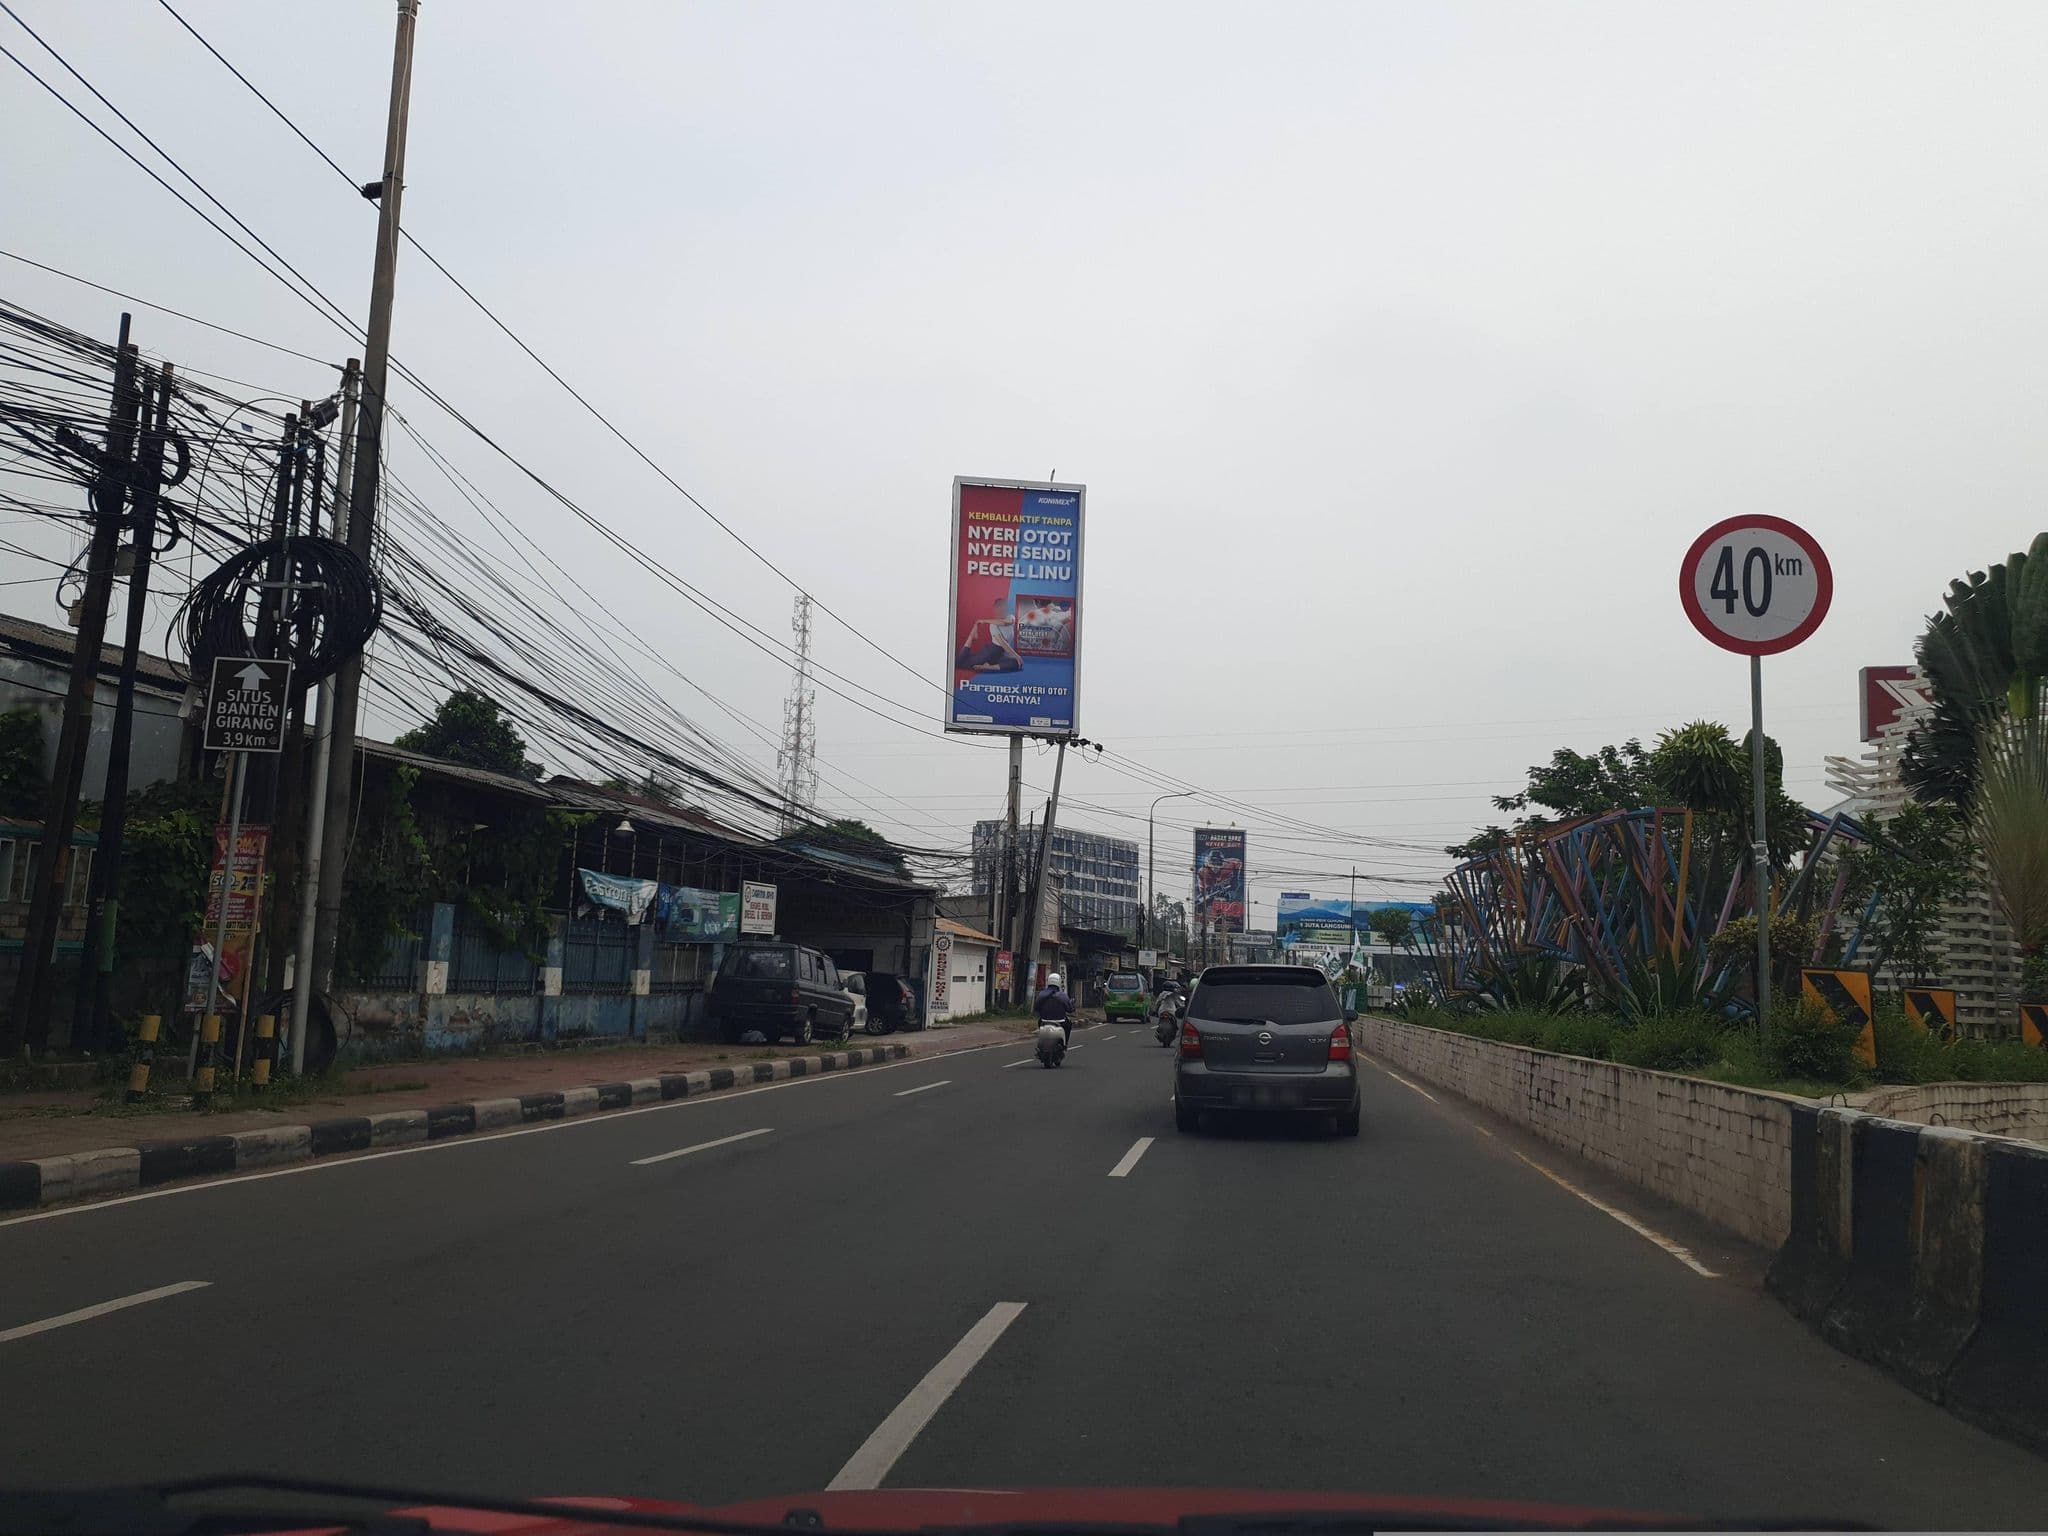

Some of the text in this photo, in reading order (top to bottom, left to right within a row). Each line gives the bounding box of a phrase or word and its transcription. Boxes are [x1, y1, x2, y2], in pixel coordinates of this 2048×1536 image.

[968, 511, 1072, 526] KEMBALI AKTIF TANPA
[968, 525, 1072, 545] NYERI OTOT
[968, 542, 1071, 562] NYERI SENDI
[967, 560, 1071, 581] PEGEL LINU
[1710, 546, 1803, 617] 40 km
[959, 679, 1068, 696] Paramex NYERI OTOT
[227, 689, 272, 703] SITUS
[987, 694, 1040, 705] OBATNYA!
[217, 701, 279, 717] BANTEN
[216, 715, 274, 730] GIRANG
[223, 732, 266, 747] 3,9 Km
